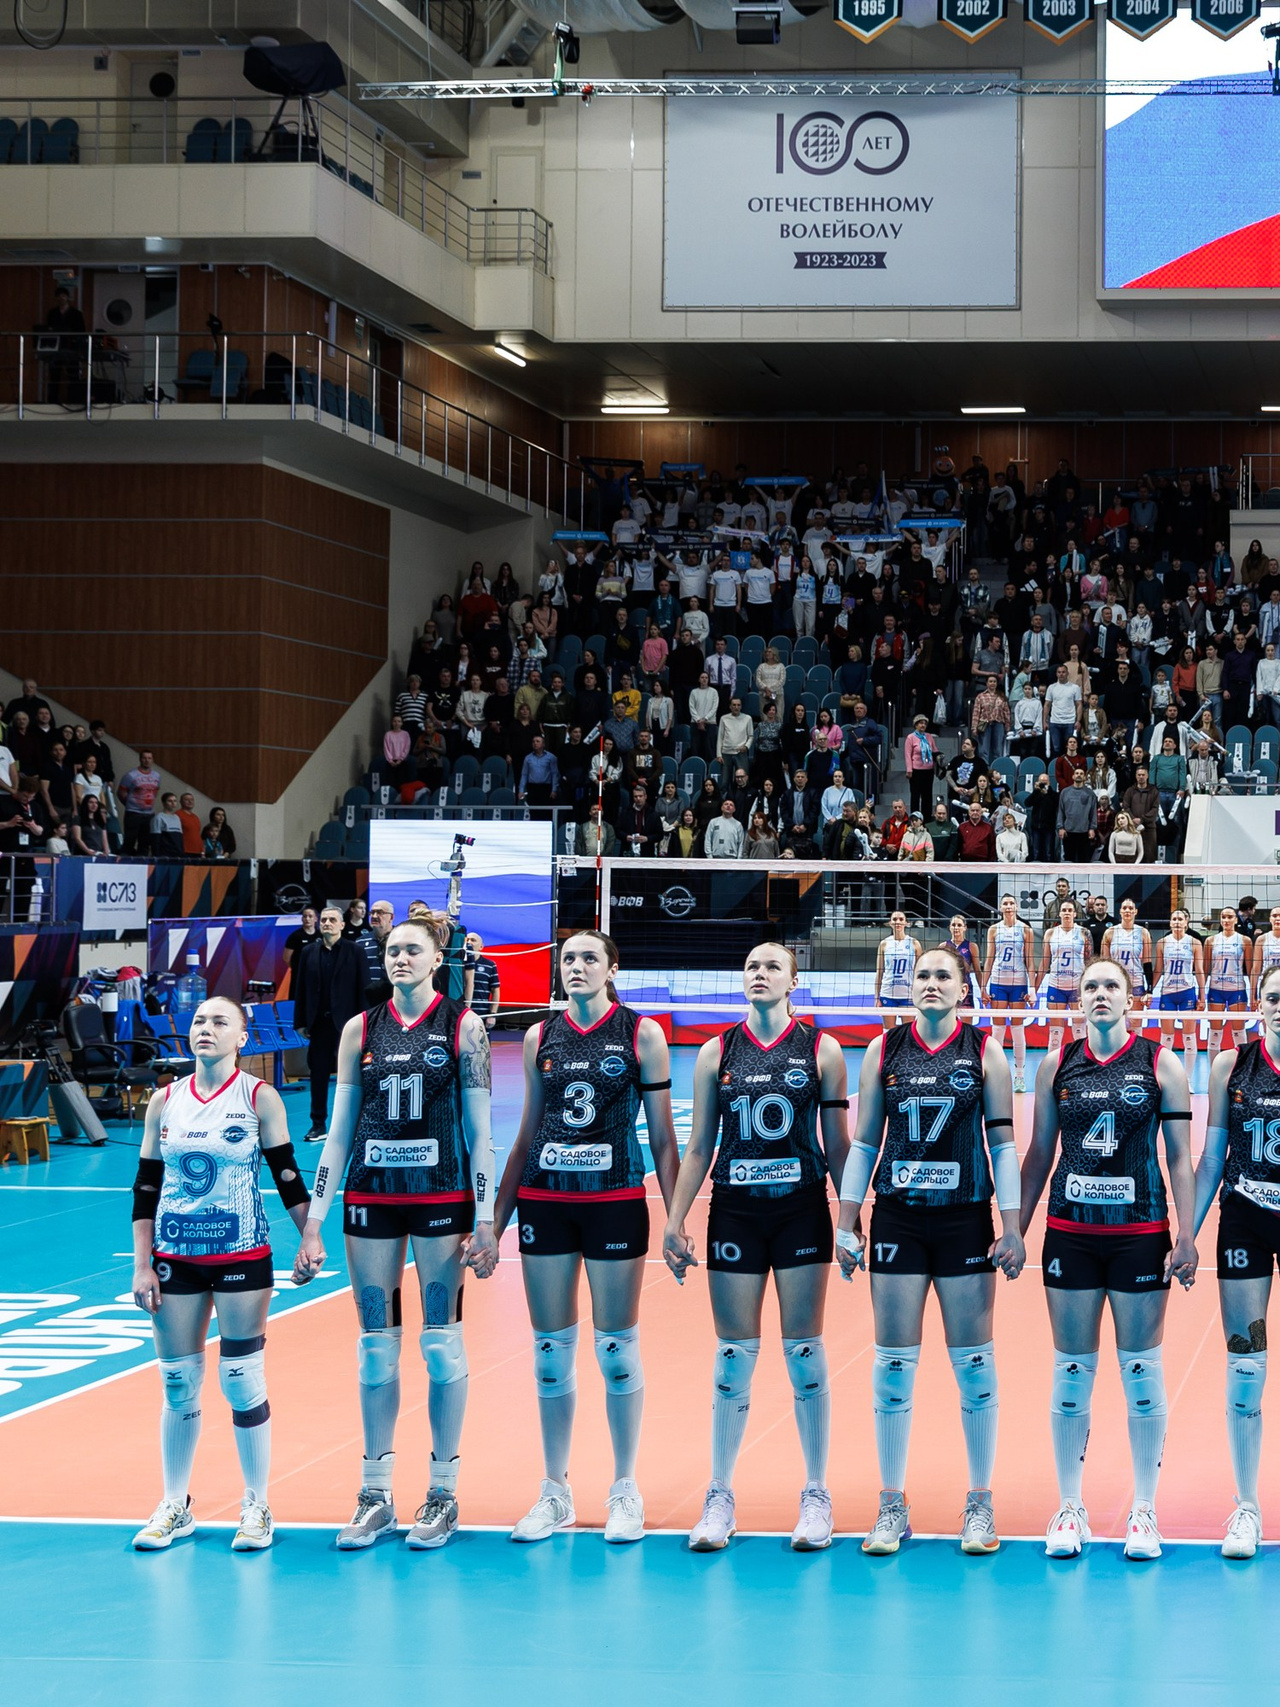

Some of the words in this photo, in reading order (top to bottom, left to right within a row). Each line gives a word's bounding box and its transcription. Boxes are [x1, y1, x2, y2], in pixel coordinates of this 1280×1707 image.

[854, 0, 886, 16] 1995
[956, 0, 990, 16] 2002
[1042, 0, 1076, 16] 2003
[1126, 0, 1160, 15] 2004
[1210, 0, 1243, 15] 2006
[862, 136, 892, 150] ЛЕТ
[748, 196, 934, 213] ОТЕЧЕСТВЕННОМУ
[780, 219, 902, 239] ВОЛЕЙБОЛУ
[804, 254, 877, 267] 1923-2023
[618, 896, 643, 906] ВФВ
[1003, 947, 1013, 962] 6
[1061, 952, 1071, 967] 5
[1121, 951, 1131, 965] 4
[893, 959, 907, 974] 10
[1170, 960, 1184, 975] 18
[380, 1074, 423, 1120] 11
[563, 1081, 596, 1128] 3
[730, 1094, 794, 1140] 10
[899, 1096, 955, 1142] 17
[1082, 1111, 1118, 1156] 4
[386, 1146, 432, 1154] САДОВОЕ
[560, 1150, 607, 1158] САДОВОЕ
[386, 1154, 427, 1162] КОЛЬЦО
[560, 1158, 600, 1166] КОЛЬЦО
[179, 1152, 217, 1197] 9
[750, 1163, 795, 1173] САДОВОЕ
[912, 1168, 954, 1176] САДОВОЕ
[750, 1171, 790, 1181] КОЛЬЦО
[910, 1176, 949, 1184] КОЛЬЦО
[1085, 1183, 1130, 1191] САДОВОЕ
[1085, 1191, 1125, 1199] КОЛЬЦО
[349, 1205, 367, 1226] 11
[429, 1218, 451, 1226] ZEDO
[183, 1222, 231, 1230] САДОВОЕ
[183, 1230, 225, 1238] КОЛЬЦО
[522, 1224, 535, 1244] 3
[712, 1240, 742, 1262] 10
[796, 1247, 817, 1255] ZEDO
[875, 1242, 898, 1262] 17
[1225, 1249, 1249, 1268] 18
[156, 1262, 172, 1282] 9
[1048, 1258, 1062, 1277] 4
[1136, 1274, 1157, 1282] ZEDO
